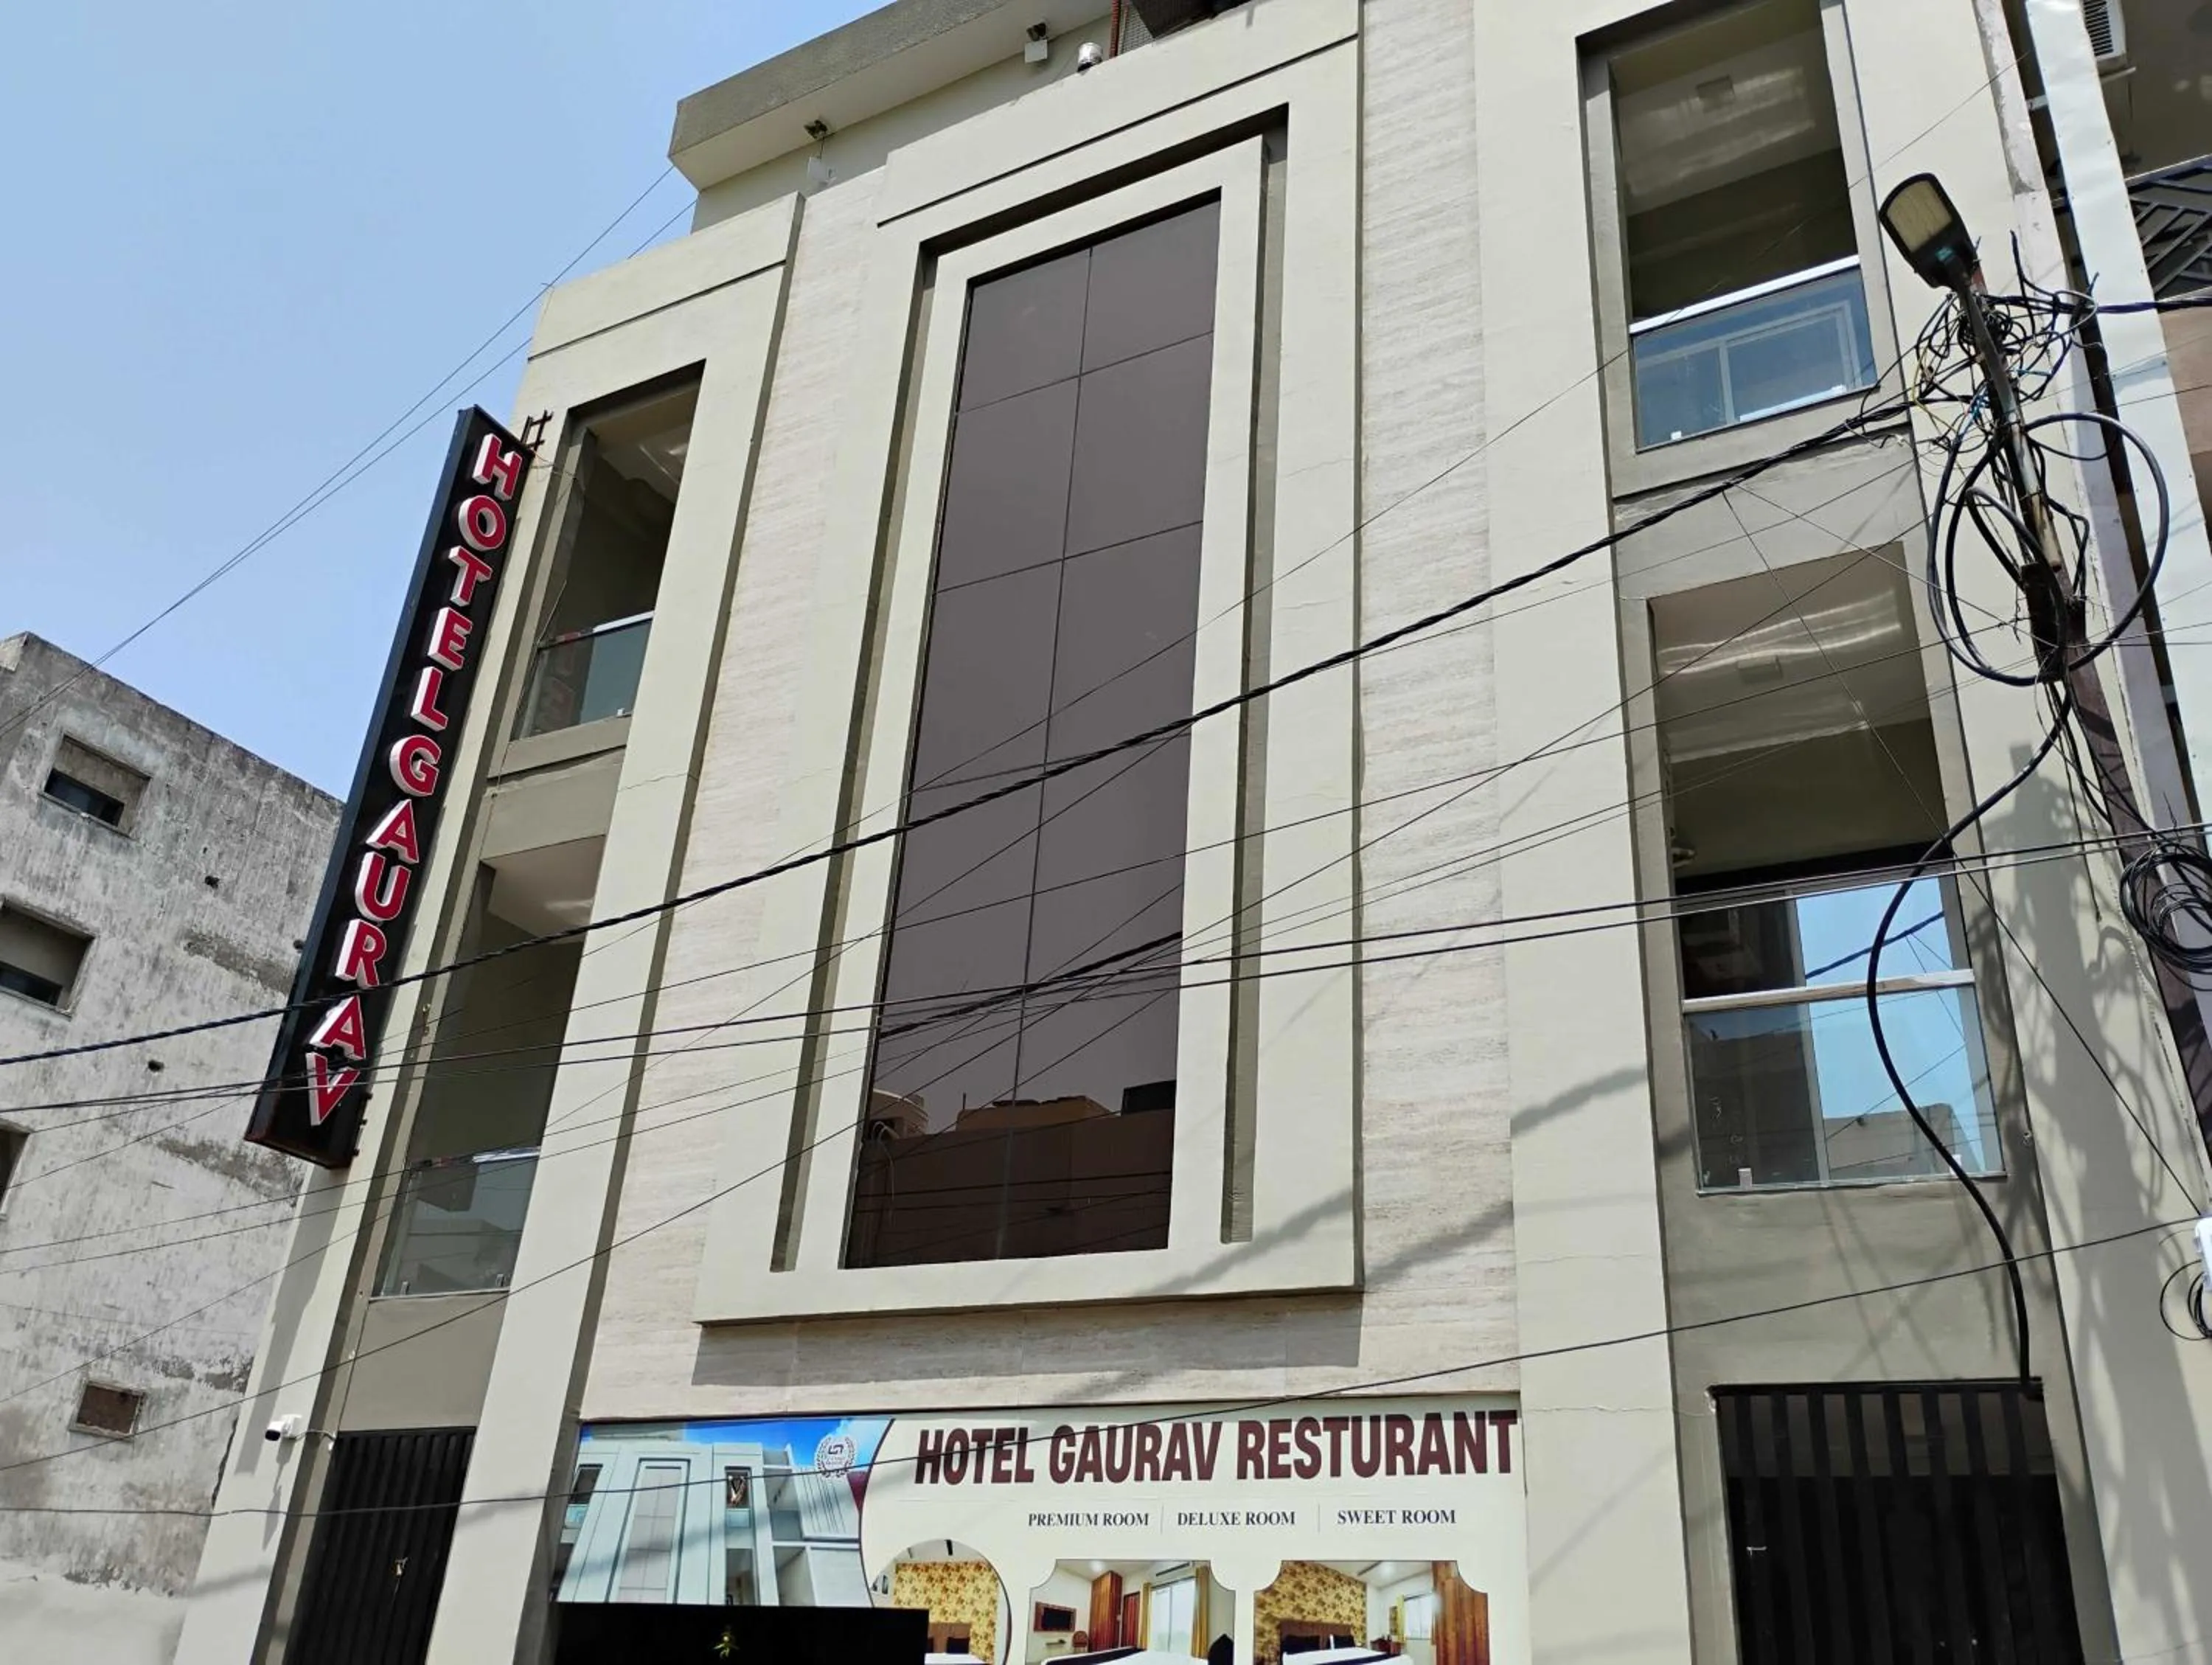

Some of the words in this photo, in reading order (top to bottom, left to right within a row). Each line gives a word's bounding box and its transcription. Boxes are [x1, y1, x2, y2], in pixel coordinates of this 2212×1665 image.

[411, 433, 522, 731] HOTEL
[306, 734, 442, 1126] GAURAV
[914, 1427, 1034, 1485] HOTEL
[1049, 1421, 1223, 1484] GAURAV
[1237, 1410, 1518, 1480] RESTURANT
[1029, 1512, 1099, 1526] PREMIUM
[1103, 1512, 1149, 1526] ROOM
[1178, 1512, 1241, 1526] DELUXE
[1245, 1511, 1296, 1526] ROOM
[1337, 1509, 1397, 1525] SWEET
[1402, 1509, 1456, 1524] ROOM
